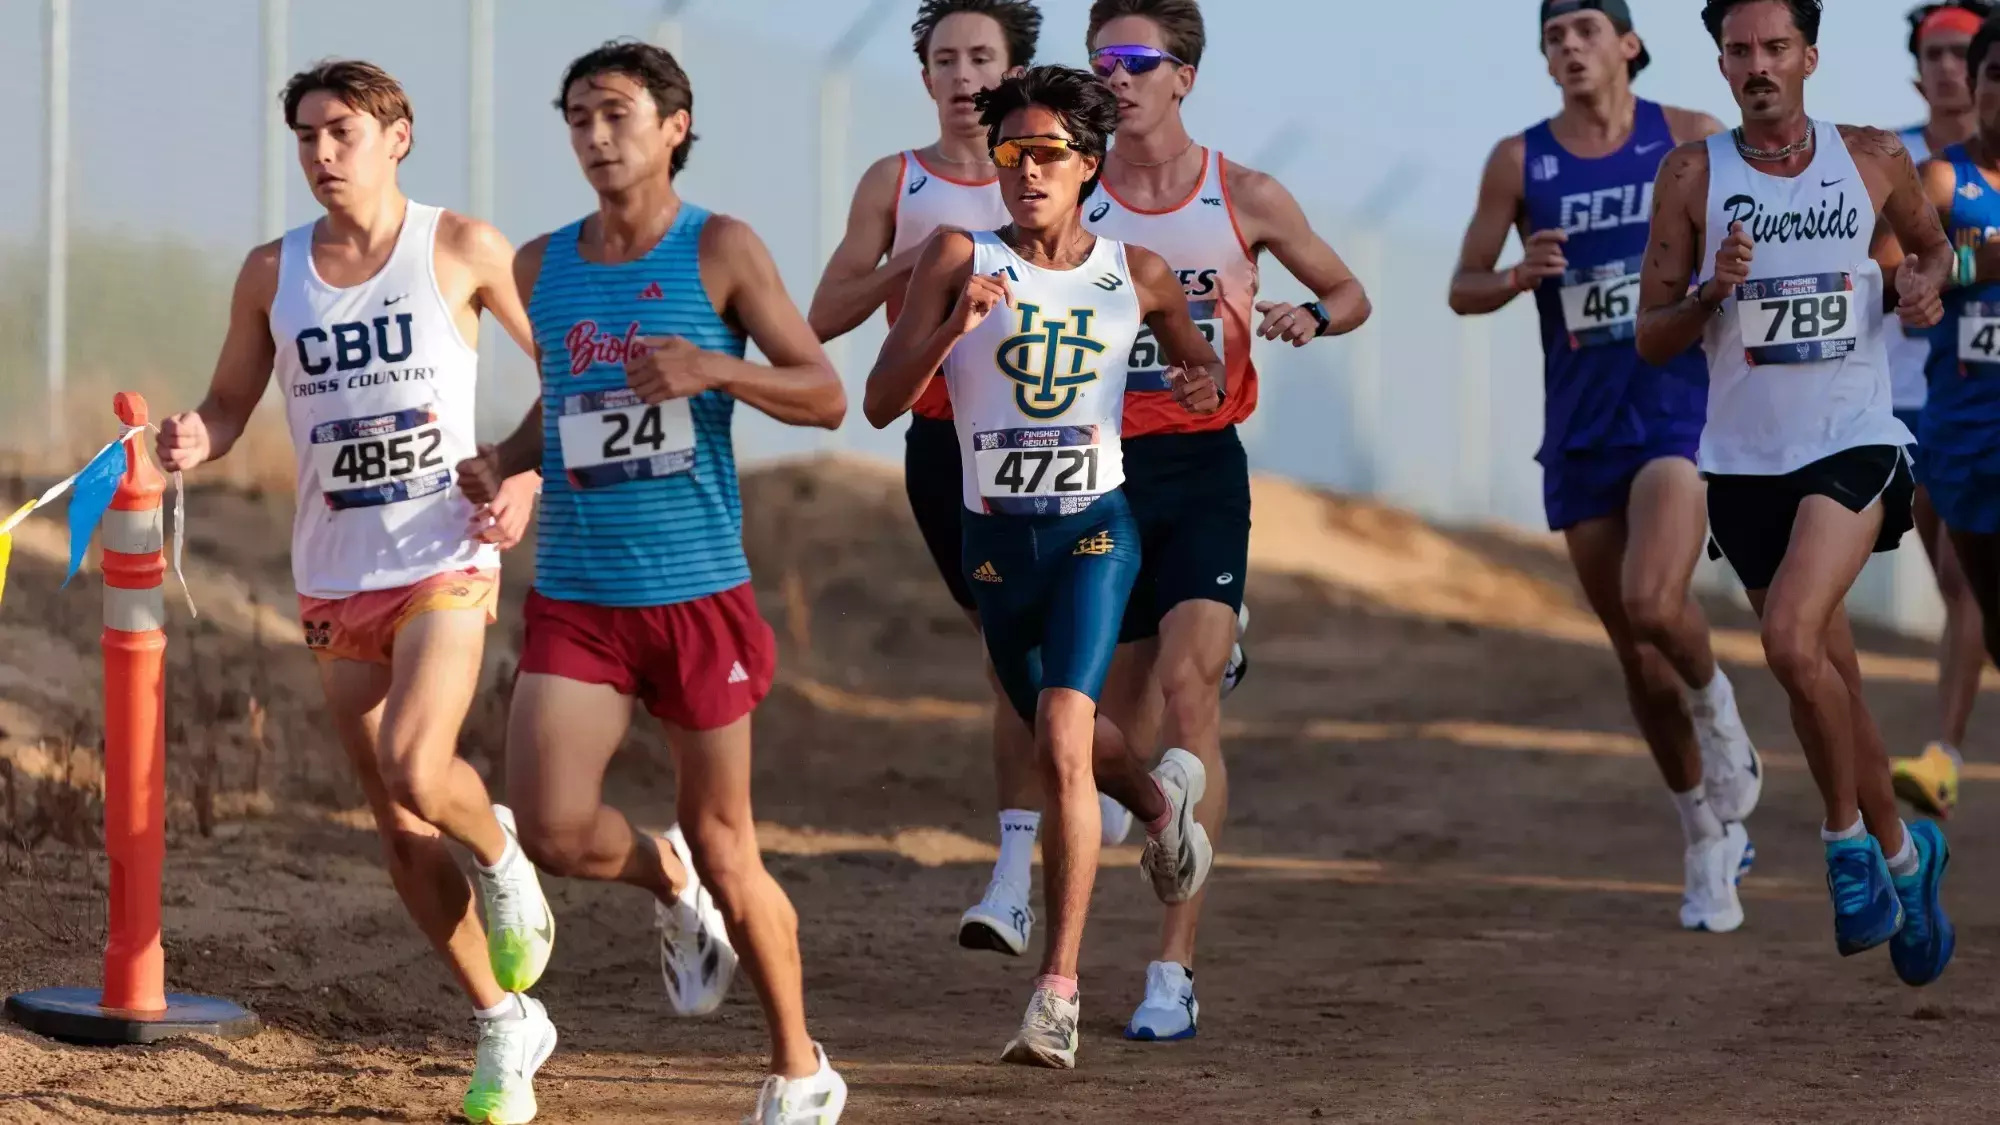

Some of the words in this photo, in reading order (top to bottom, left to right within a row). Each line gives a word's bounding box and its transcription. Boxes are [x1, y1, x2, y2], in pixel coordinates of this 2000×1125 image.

[1561, 181, 1655, 235] GCU
[1174, 269, 1218, 296] ES
[1583, 279, 1640, 322] 46
[1761, 294, 1847, 342] 789
[1970, 322, 2000, 356] 4
[296, 313, 413, 376] CBU
[293, 378, 340, 398] CROSS
[347, 366, 438, 389] COUNTRY
[602, 405, 665, 458] 24
[1022, 438, 1059, 447] RESULTS
[1023, 430, 1060, 438] FINISHED
[332, 428, 444, 483] 4852
[995, 447, 1098, 493] 4721
[972, 572, 1003, 583] adidas
